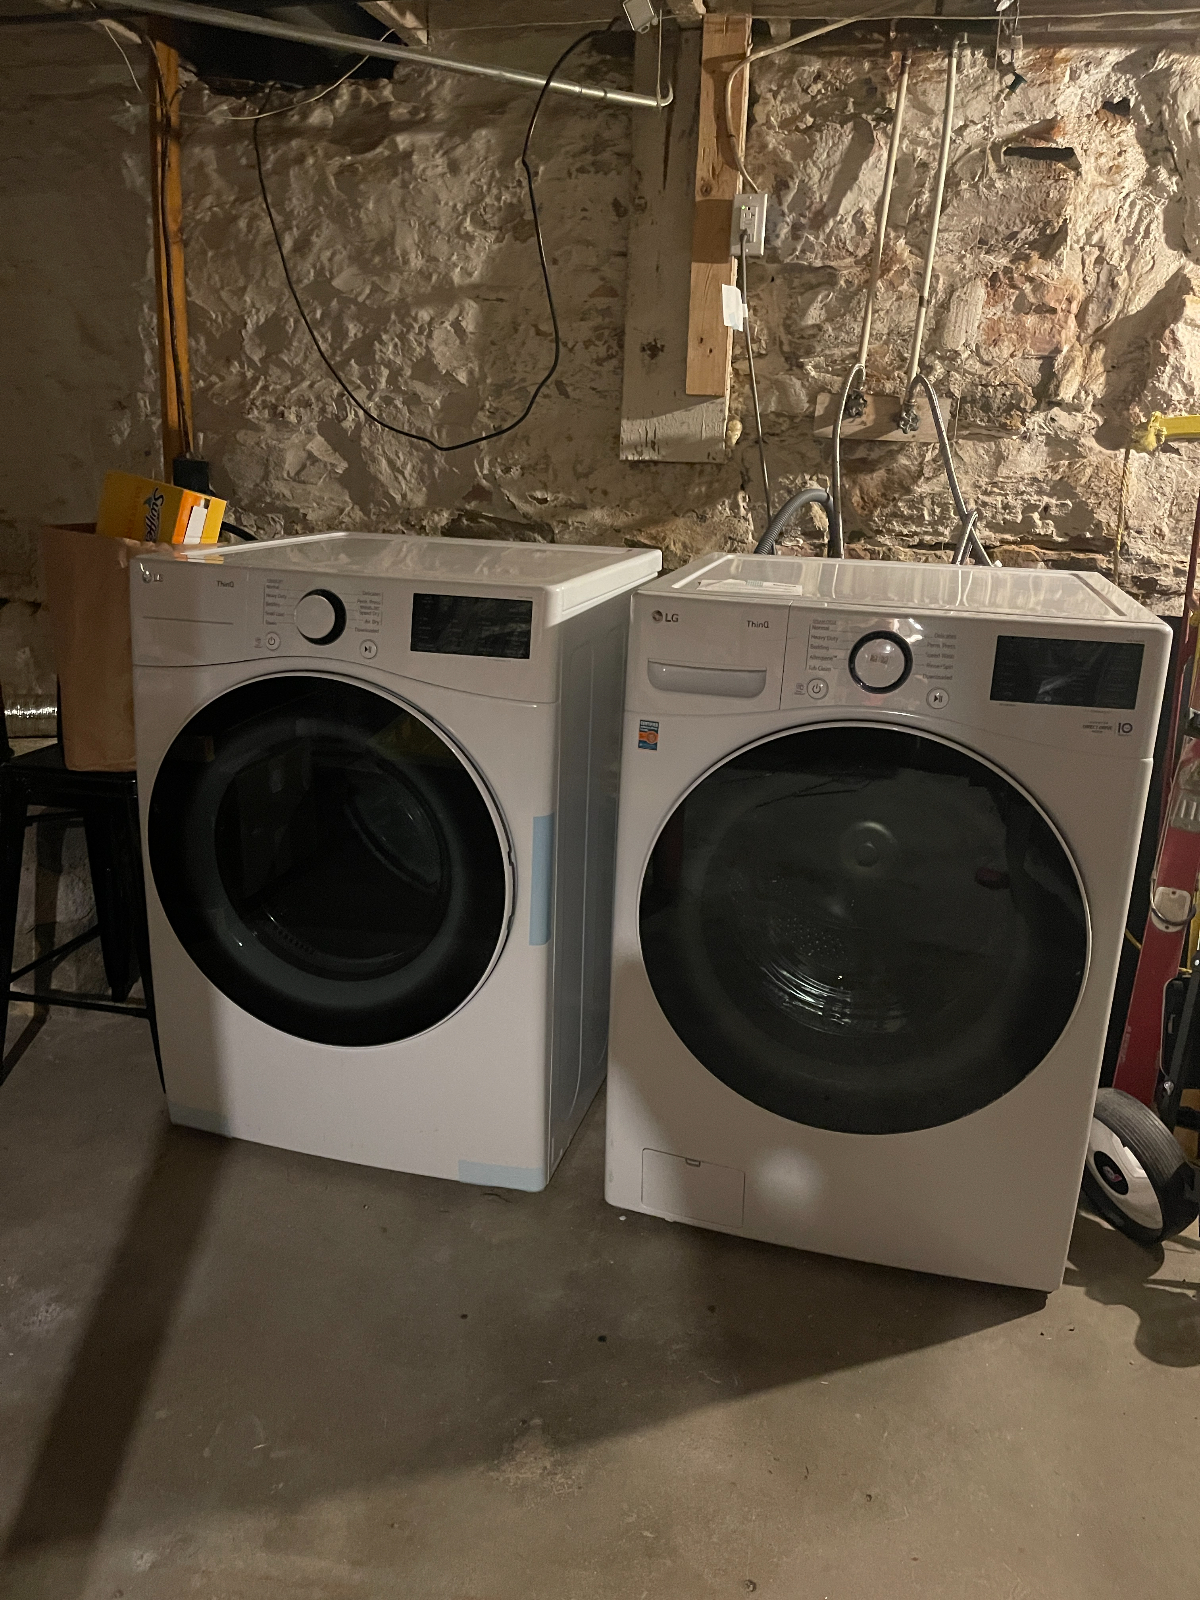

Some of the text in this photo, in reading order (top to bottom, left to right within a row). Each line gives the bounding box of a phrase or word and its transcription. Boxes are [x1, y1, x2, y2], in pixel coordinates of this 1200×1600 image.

[217, 580, 235, 588] ThinQ
[664, 612, 679, 623] LG
[746, 619, 770, 629] ThinQ
